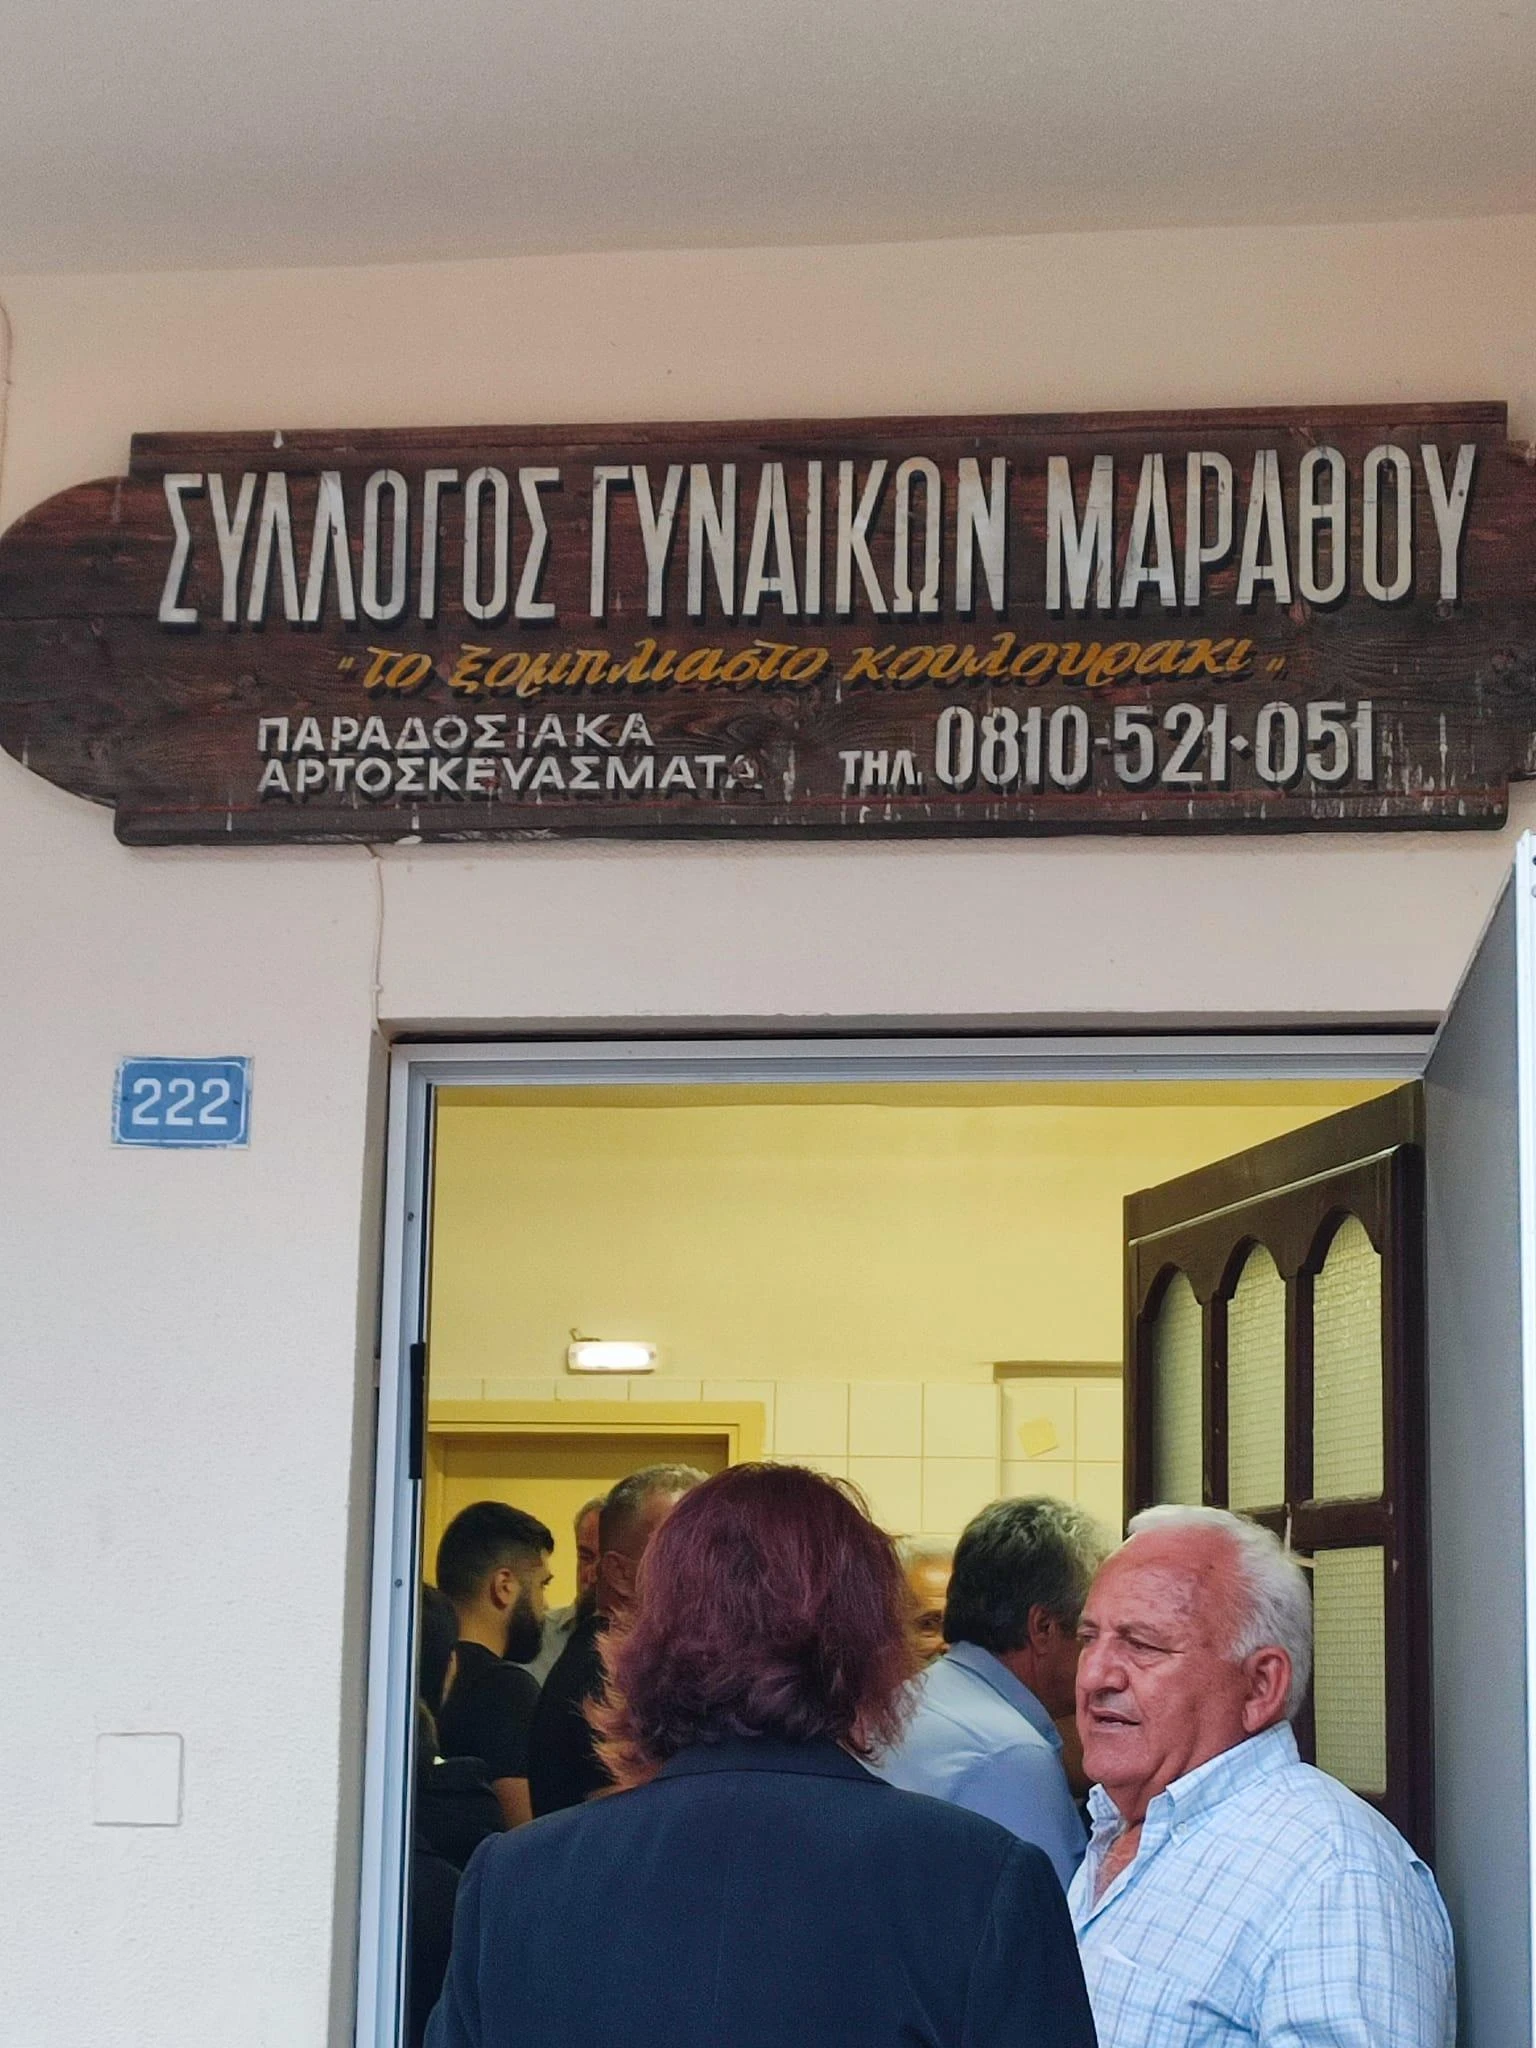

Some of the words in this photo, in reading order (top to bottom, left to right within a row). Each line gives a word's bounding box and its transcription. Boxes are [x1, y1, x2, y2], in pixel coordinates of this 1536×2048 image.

[159, 467, 560, 622] ΣΥΛΛΟΓΟΣ
[590, 456, 1007, 618] ΓΥΝΑΙΚΩΝ
[1046, 444, 1477, 609] ΜΑΡΑΘΟΥ
[257, 713, 656, 752] ΠΑΡΑΔΟΣΙΑΚΑ
[257, 755, 763, 793] ΑΡΤΟΣΚΕΥΑΣΜΑΤΑ
[131, 1077, 231, 1126] 222
